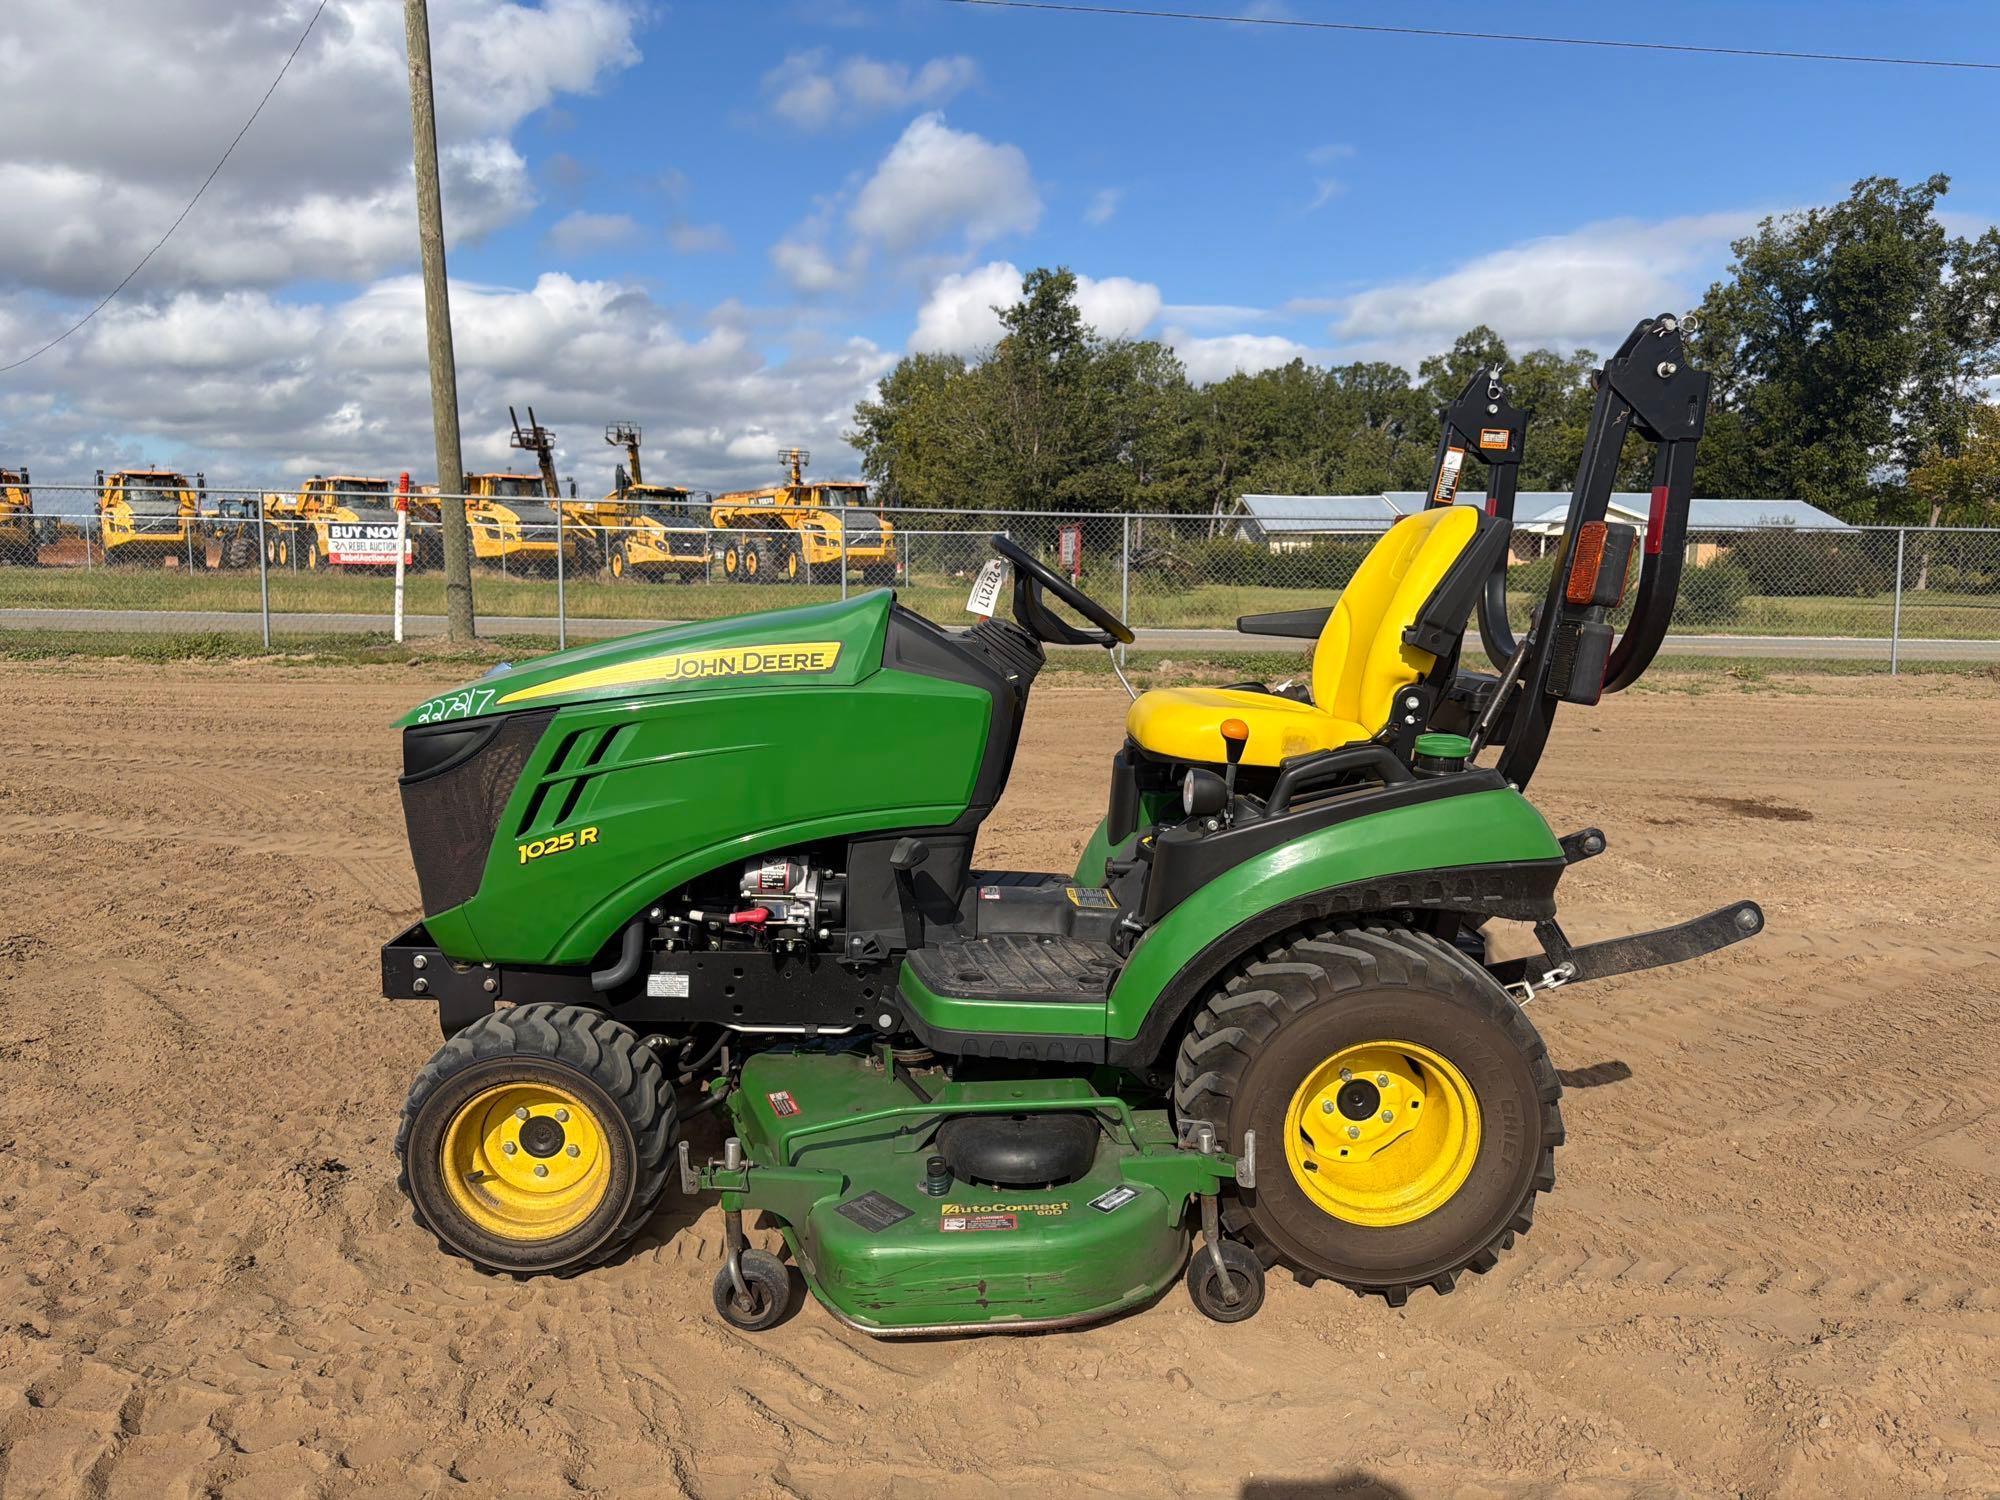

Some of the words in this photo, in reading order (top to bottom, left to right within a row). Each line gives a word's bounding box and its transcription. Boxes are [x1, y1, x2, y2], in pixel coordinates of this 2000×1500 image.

[331, 525, 362, 539] BUY
[348, 541, 367, 552] REBEL
[978, 570, 1001, 608] 227217
[665, 656, 736, 678] JOHN
[743, 652, 825, 672] DEERE
[416, 688, 496, 723] 227217
[518, 832, 575, 864] 1025
[580, 826, 598, 846] R
[942, 1202, 1070, 1216] AutoConnect
